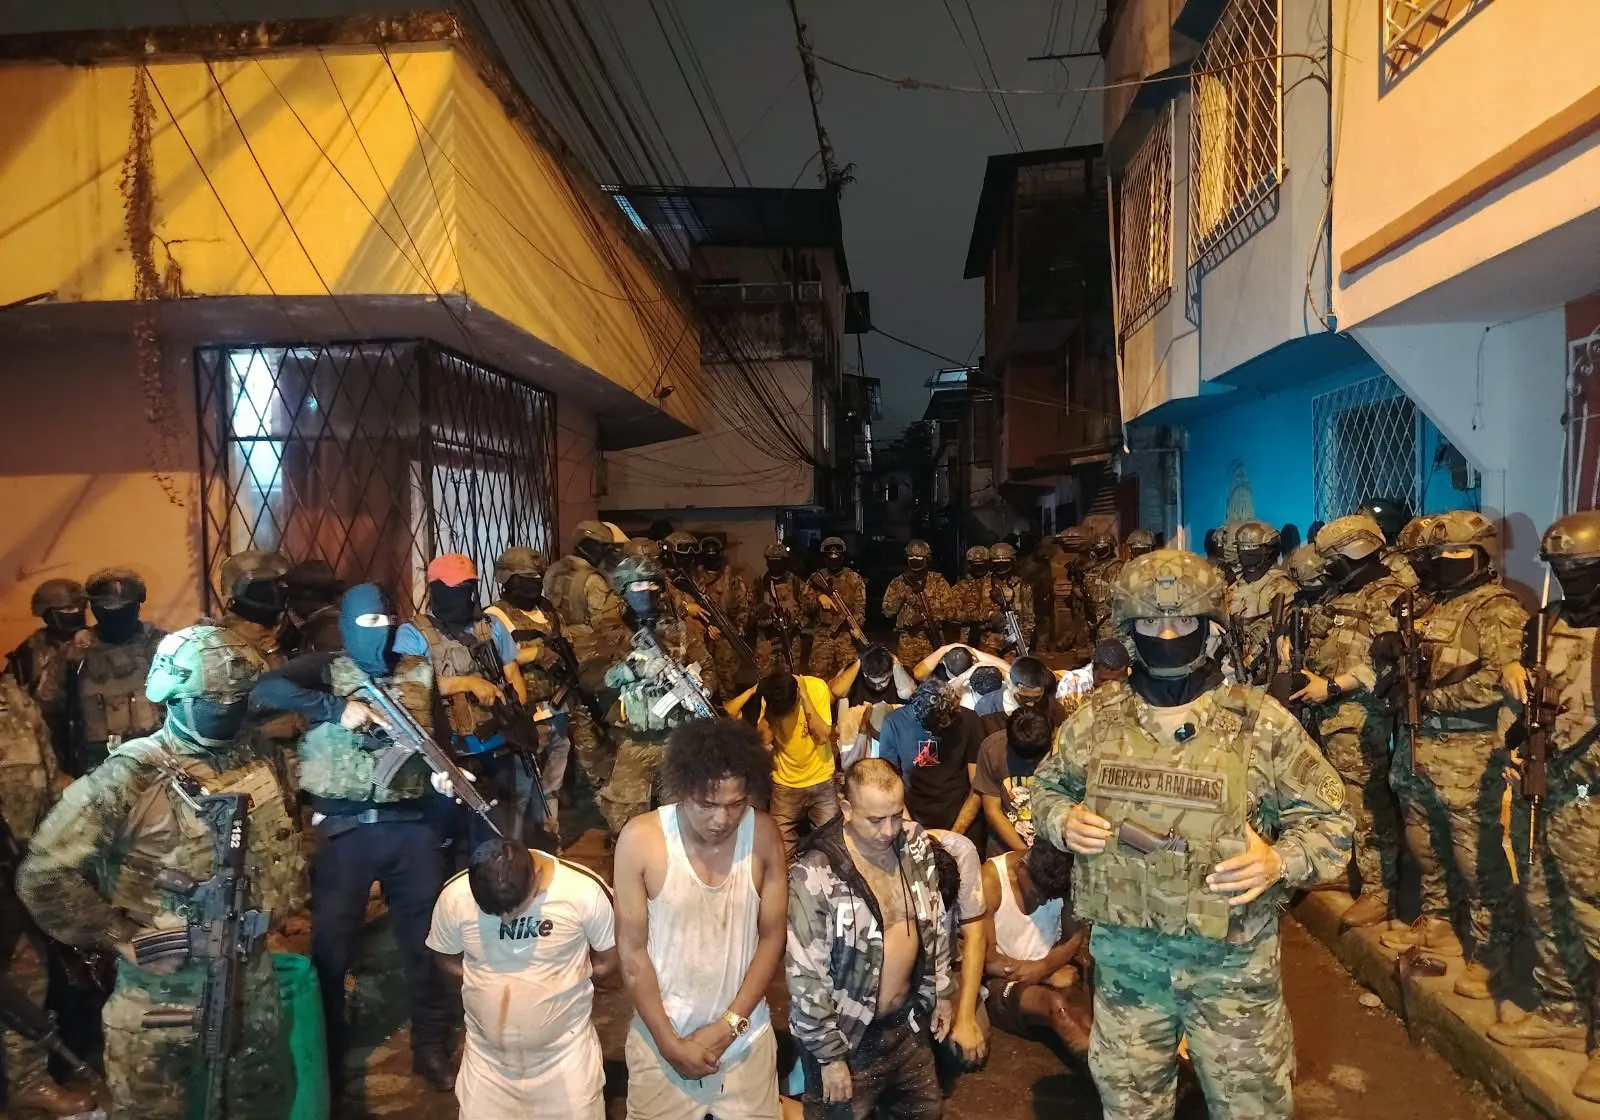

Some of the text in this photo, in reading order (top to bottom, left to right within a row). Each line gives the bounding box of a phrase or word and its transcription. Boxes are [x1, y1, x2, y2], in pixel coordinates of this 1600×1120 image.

[1101, 767, 1219, 800] FUERZAS ARMADAS
[499, 916, 554, 940] Nike
